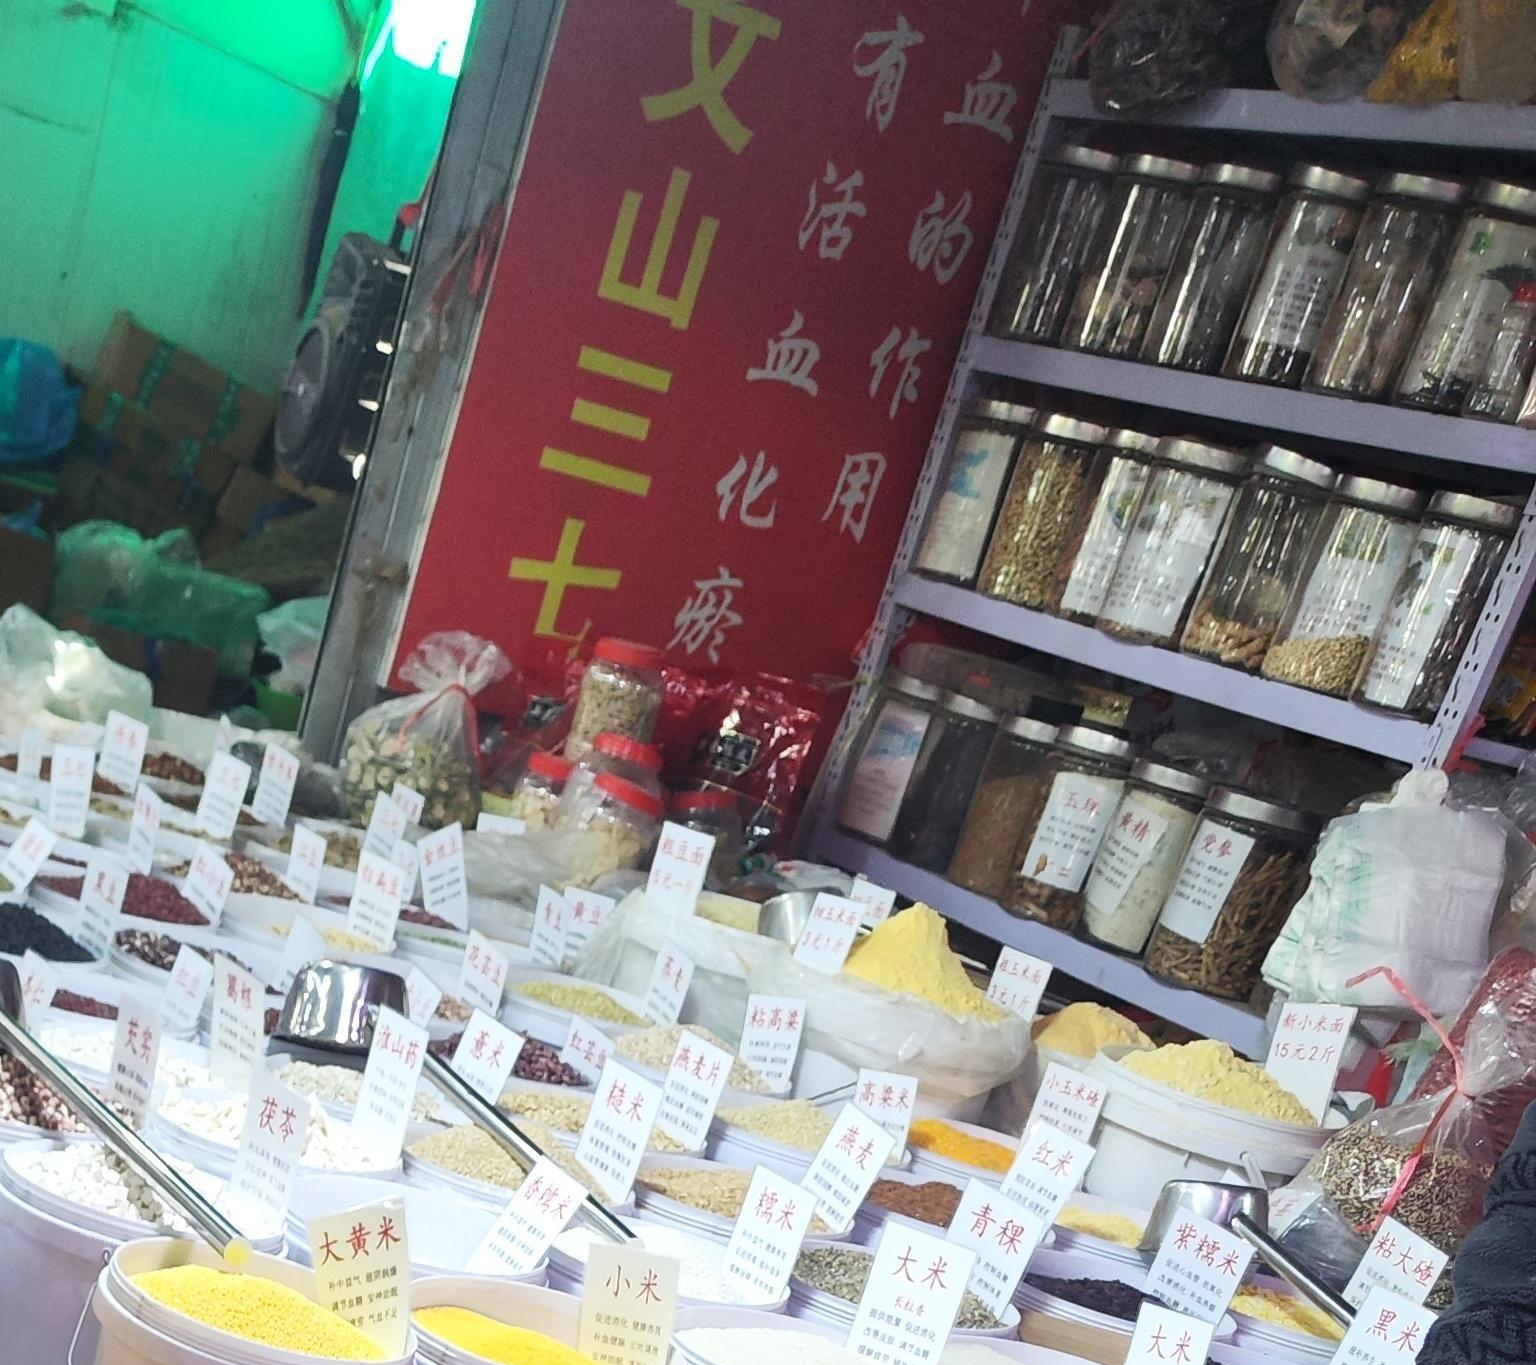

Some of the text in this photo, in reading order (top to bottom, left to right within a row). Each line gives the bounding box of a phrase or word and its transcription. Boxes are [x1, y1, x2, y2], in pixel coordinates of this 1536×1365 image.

[508, 0, 782, 650] 文山三七
[667, 15, 924, 664] 有活血化瘀
[1281, 1012, 1344, 1034] 新小米面
[673, 1045, 722, 1088] 燕麦片
[1273, 1042, 1336, 1062] 15元2斤
[605, 1078, 646, 1123] 糙米
[858, 1079, 911, 1113] 高粱米
[258, 1095, 297, 1145] 茯苓
[835, 1124, 875, 1171] 燕麦
[1031, 1139, 1074, 1178] 红米
[755, 1185, 797, 1232] 糯米
[971, 1202, 1026, 1255] 青稞
[318, 1215, 402, 1266] 大黄米
[1172, 1222, 1240, 1278] 紫糯米
[1372, 1230, 1436, 1288] 粘大碴
[604, 1264, 663, 1305] 小米
[891, 1245, 948, 1291] 大米
[1145, 1323, 1192, 1365] 大米
[1365, 1307, 1421, 1353] 黑米
